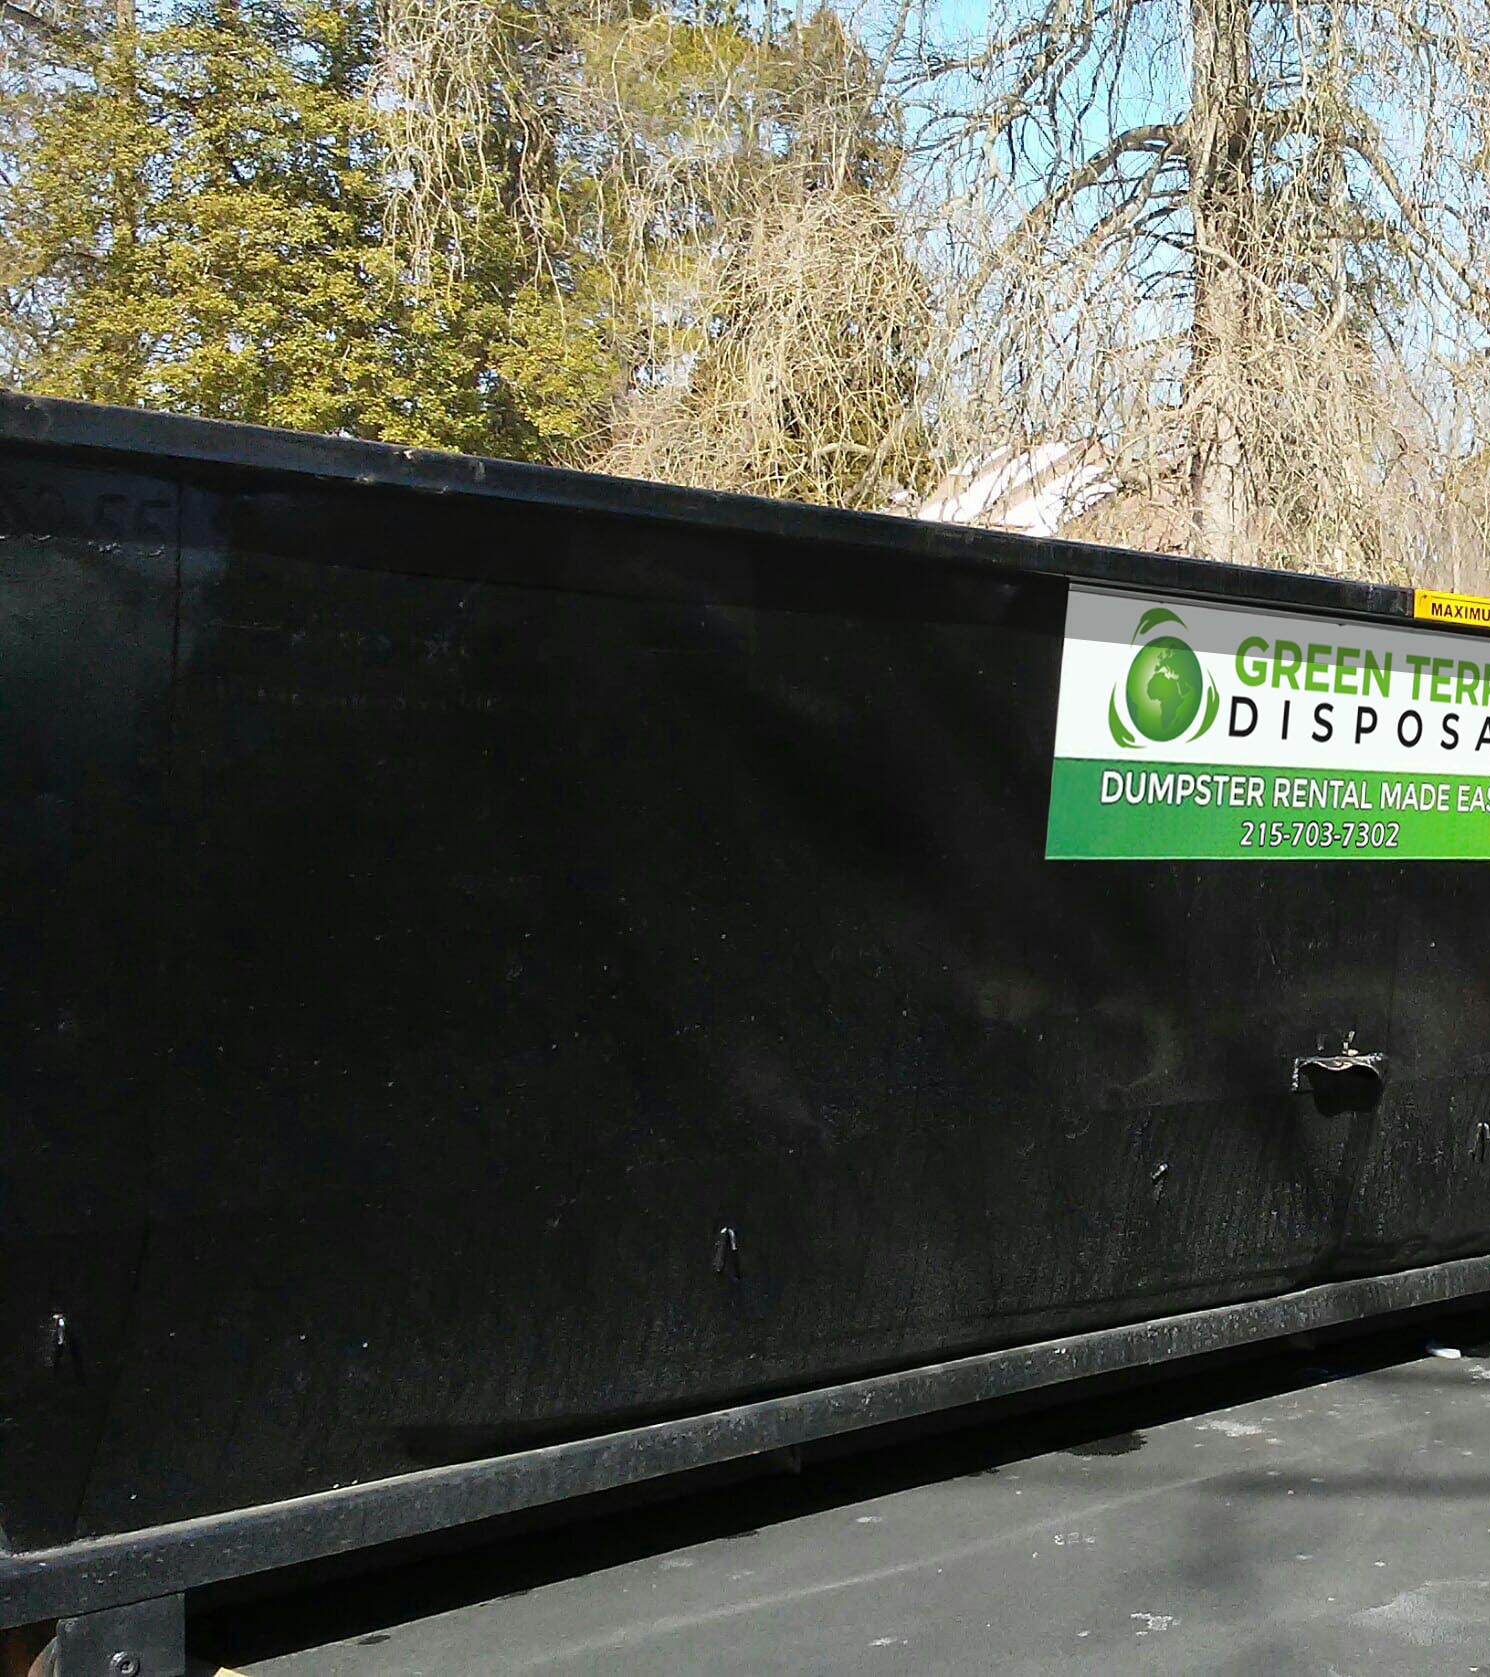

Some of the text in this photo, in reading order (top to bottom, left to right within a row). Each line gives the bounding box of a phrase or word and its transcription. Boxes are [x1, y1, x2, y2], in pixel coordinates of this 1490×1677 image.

[1236, 636, 1392, 698] GREEN
[1100, 770, 1265, 809] DUMPSTER
[1273, 777, 1373, 810] RENTAL
[1381, 782, 1451, 812] MADE
[1240, 821, 1400, 848] 215-703-7302
